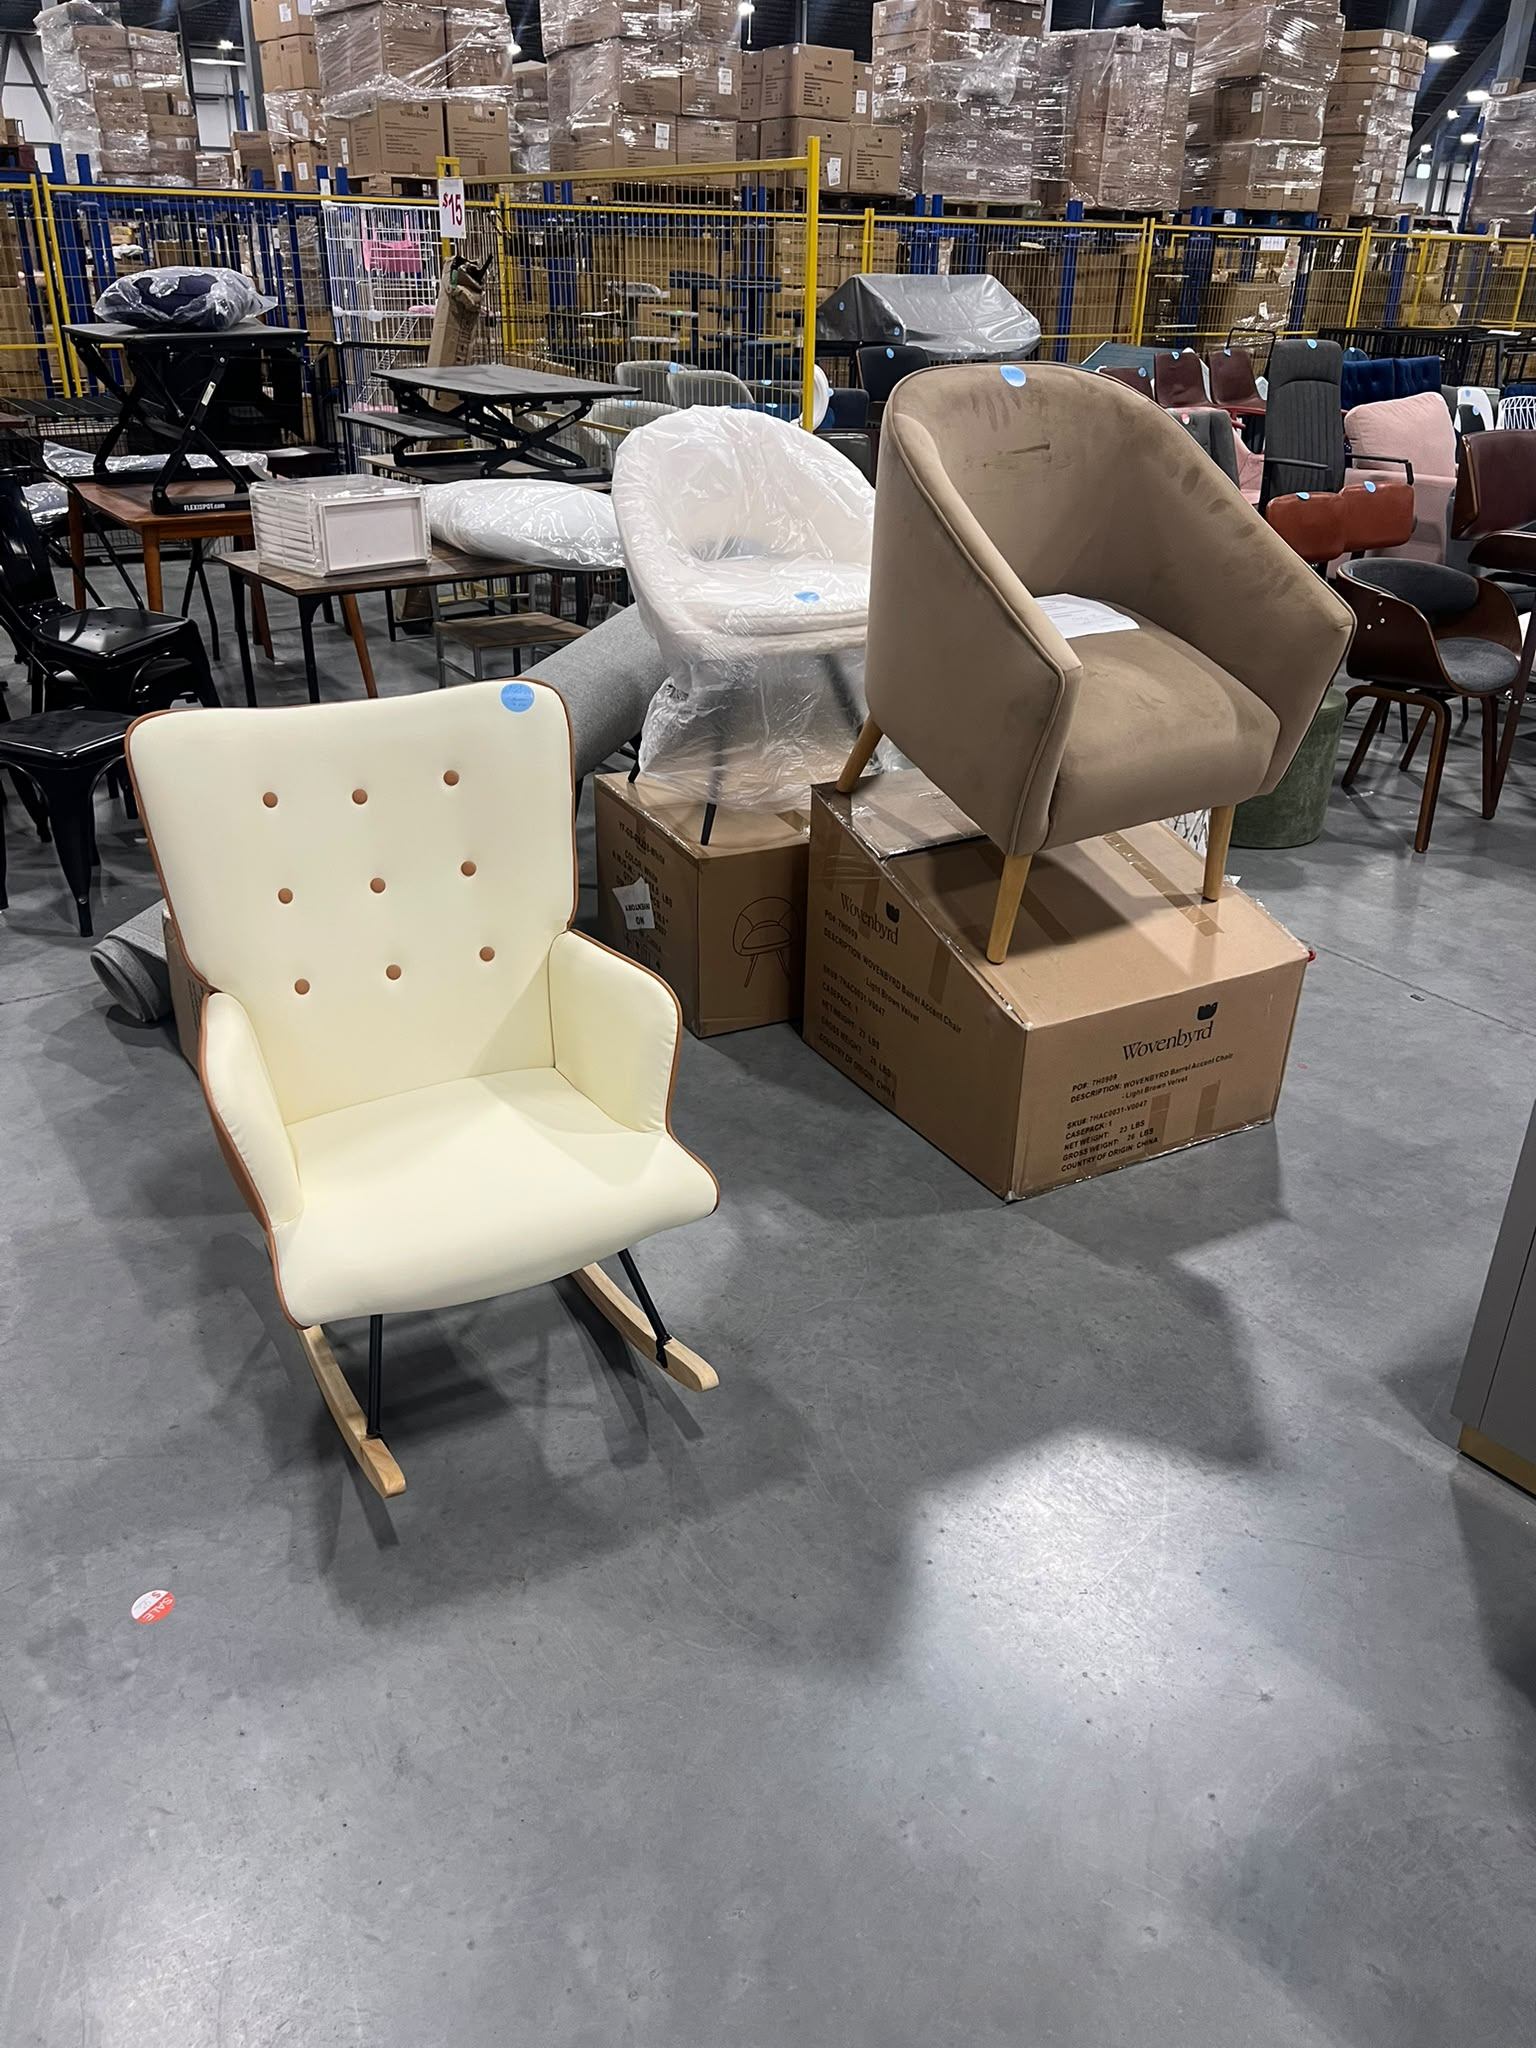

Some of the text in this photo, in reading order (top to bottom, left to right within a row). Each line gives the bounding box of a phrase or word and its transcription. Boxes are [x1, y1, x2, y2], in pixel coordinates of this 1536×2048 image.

[443, 192, 463, 226] $15
[840, 892, 899, 946] Wovenbyrd
[1122, 1021, 1214, 1061] Wovenbyrd
[1123, 1070, 1169, 1090] WOVENBYRD
[1170, 1064, 1191, 1076] Barrel
[1191, 1057, 1214, 1069] Accent
[1215, 1053, 1234, 1063] Chair
[1144, 1083, 1166, 1094] Brown
[1167, 1076, 1188, 1086] Velvet
[1062, 1148, 1088, 1161] GROSS
[1139, 1127, 1154, 1138] LBS
[1064, 1140, 1078, 1151] NET
[1130, 1120, 1145, 1130] LBS
[1061, 1156, 1097, 1172] COUNTRY
[1097, 1152, 1107, 1161] OF
[1136, 1137, 1158, 1149] CHINA
